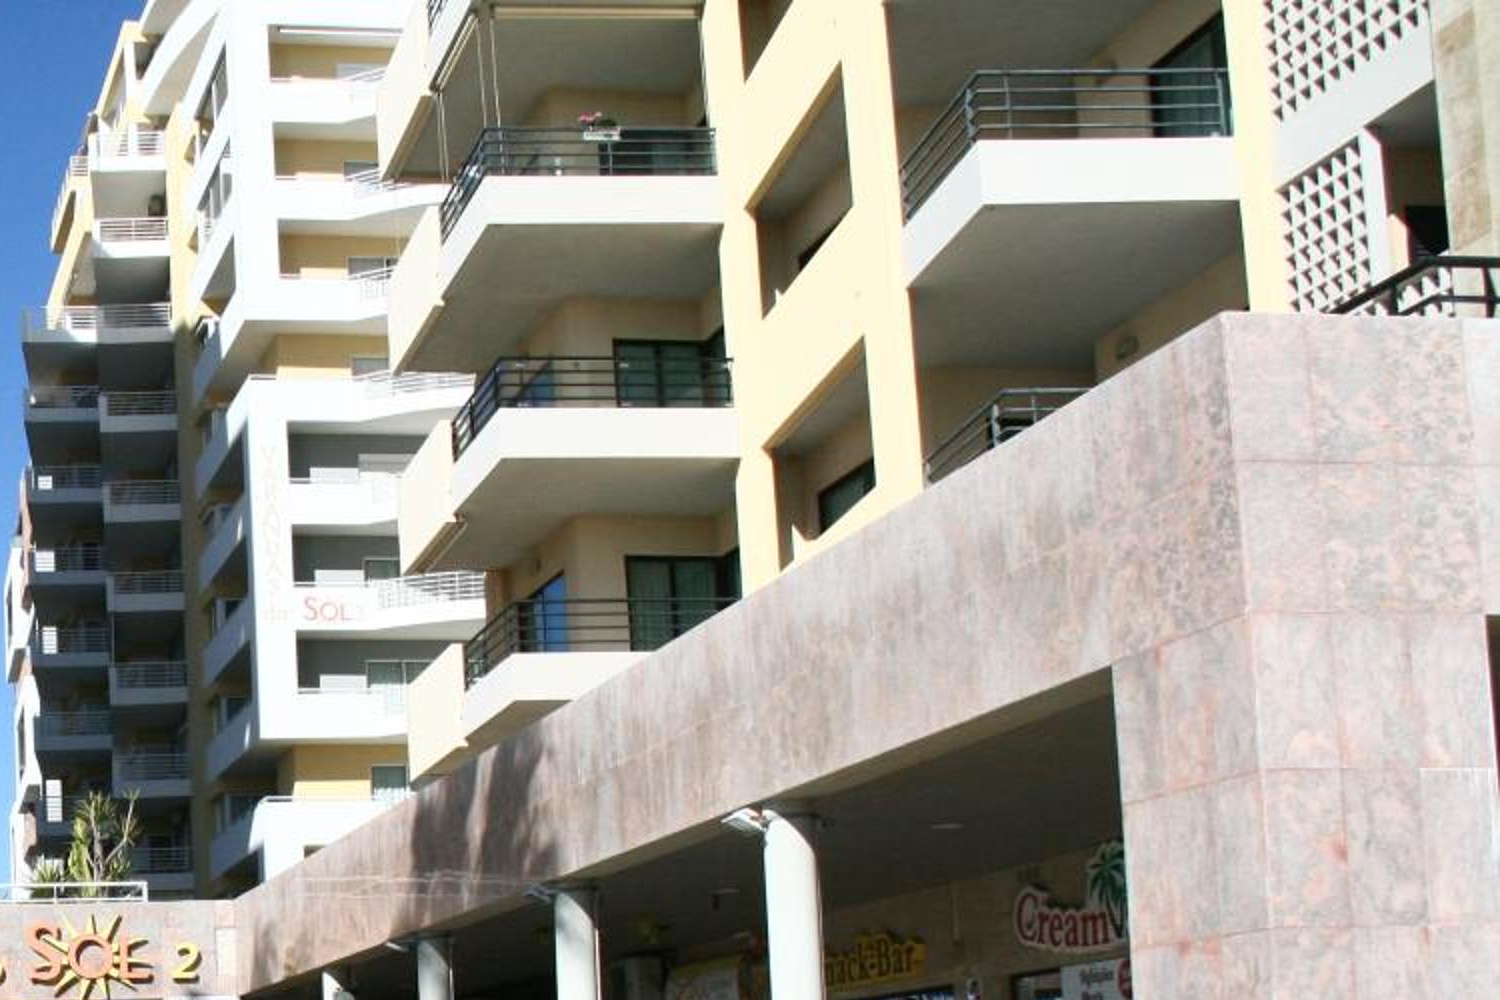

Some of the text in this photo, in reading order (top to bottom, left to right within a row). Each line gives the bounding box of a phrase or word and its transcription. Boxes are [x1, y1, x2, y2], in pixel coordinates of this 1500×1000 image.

[1015, 891, 1111, 948] Cream
[25, 919, 155, 984] SOL
[172, 940, 203, 984] 2
